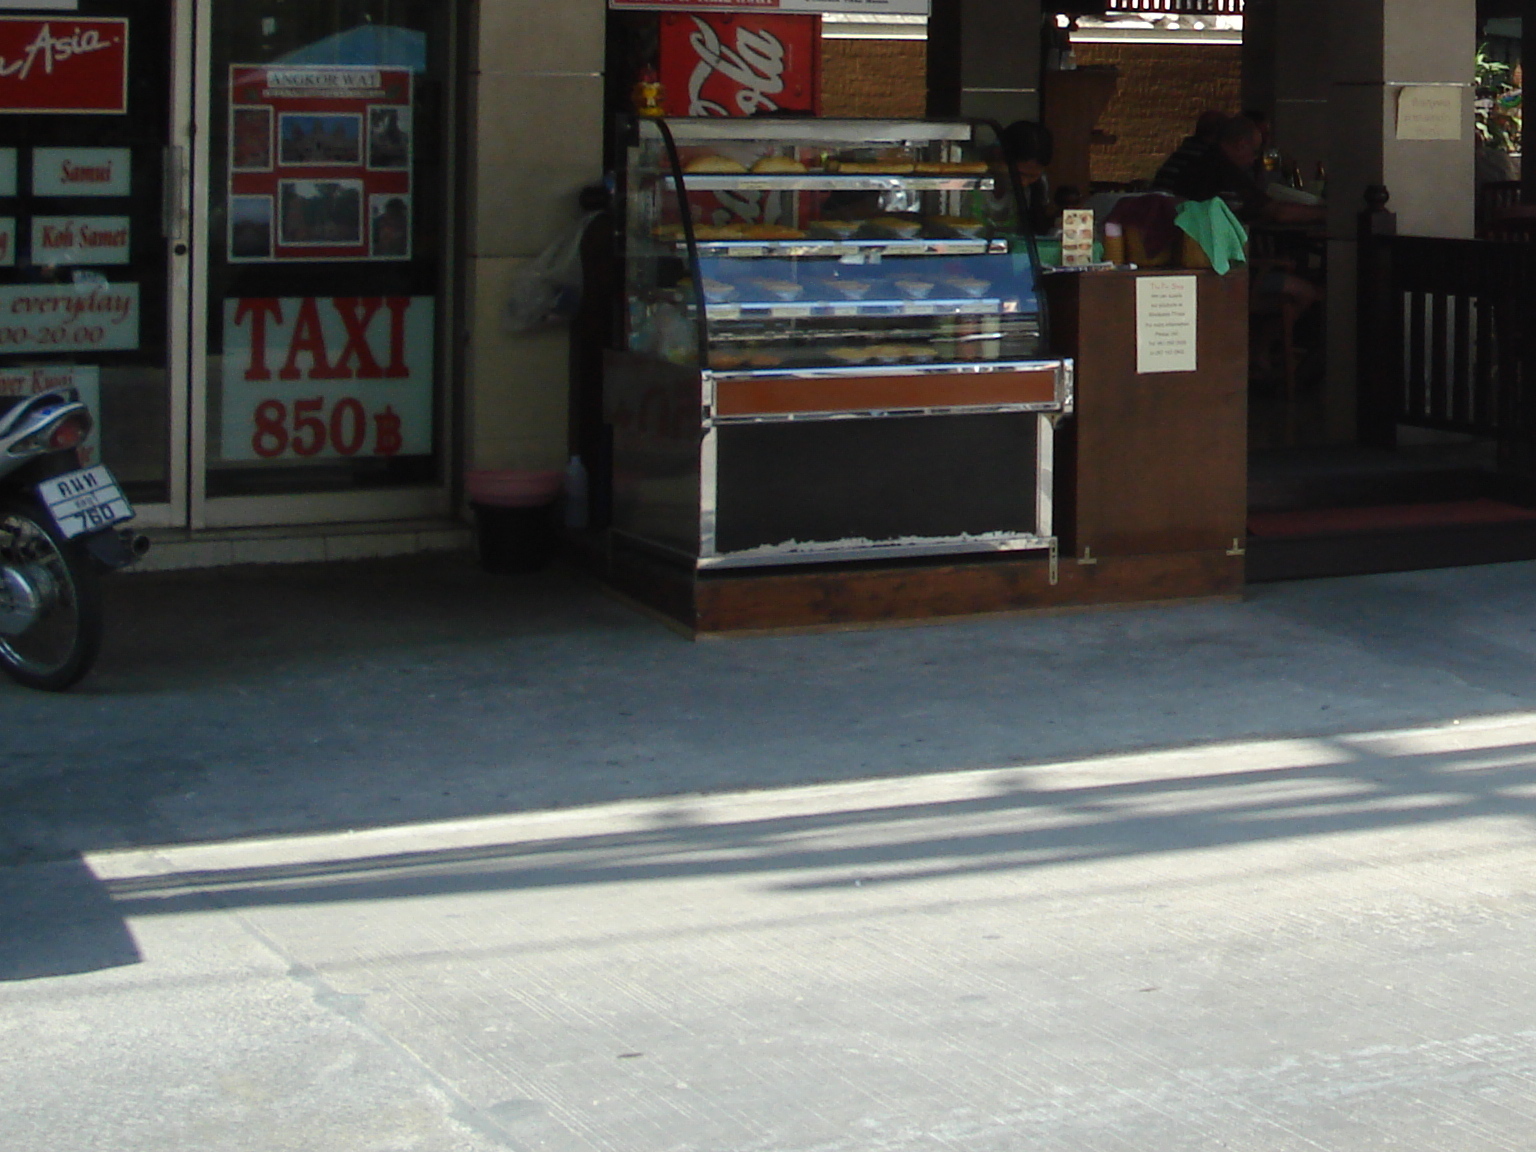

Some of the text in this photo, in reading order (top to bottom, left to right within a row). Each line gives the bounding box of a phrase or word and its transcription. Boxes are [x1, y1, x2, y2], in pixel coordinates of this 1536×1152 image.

[60, 158, 112, 184] Samui
[42, 219, 128, 248] Koh Samet
[11, 284, 131, 325] everyday
[234, 296, 411, 381] TAXI
[74, 504, 116, 530] 760
